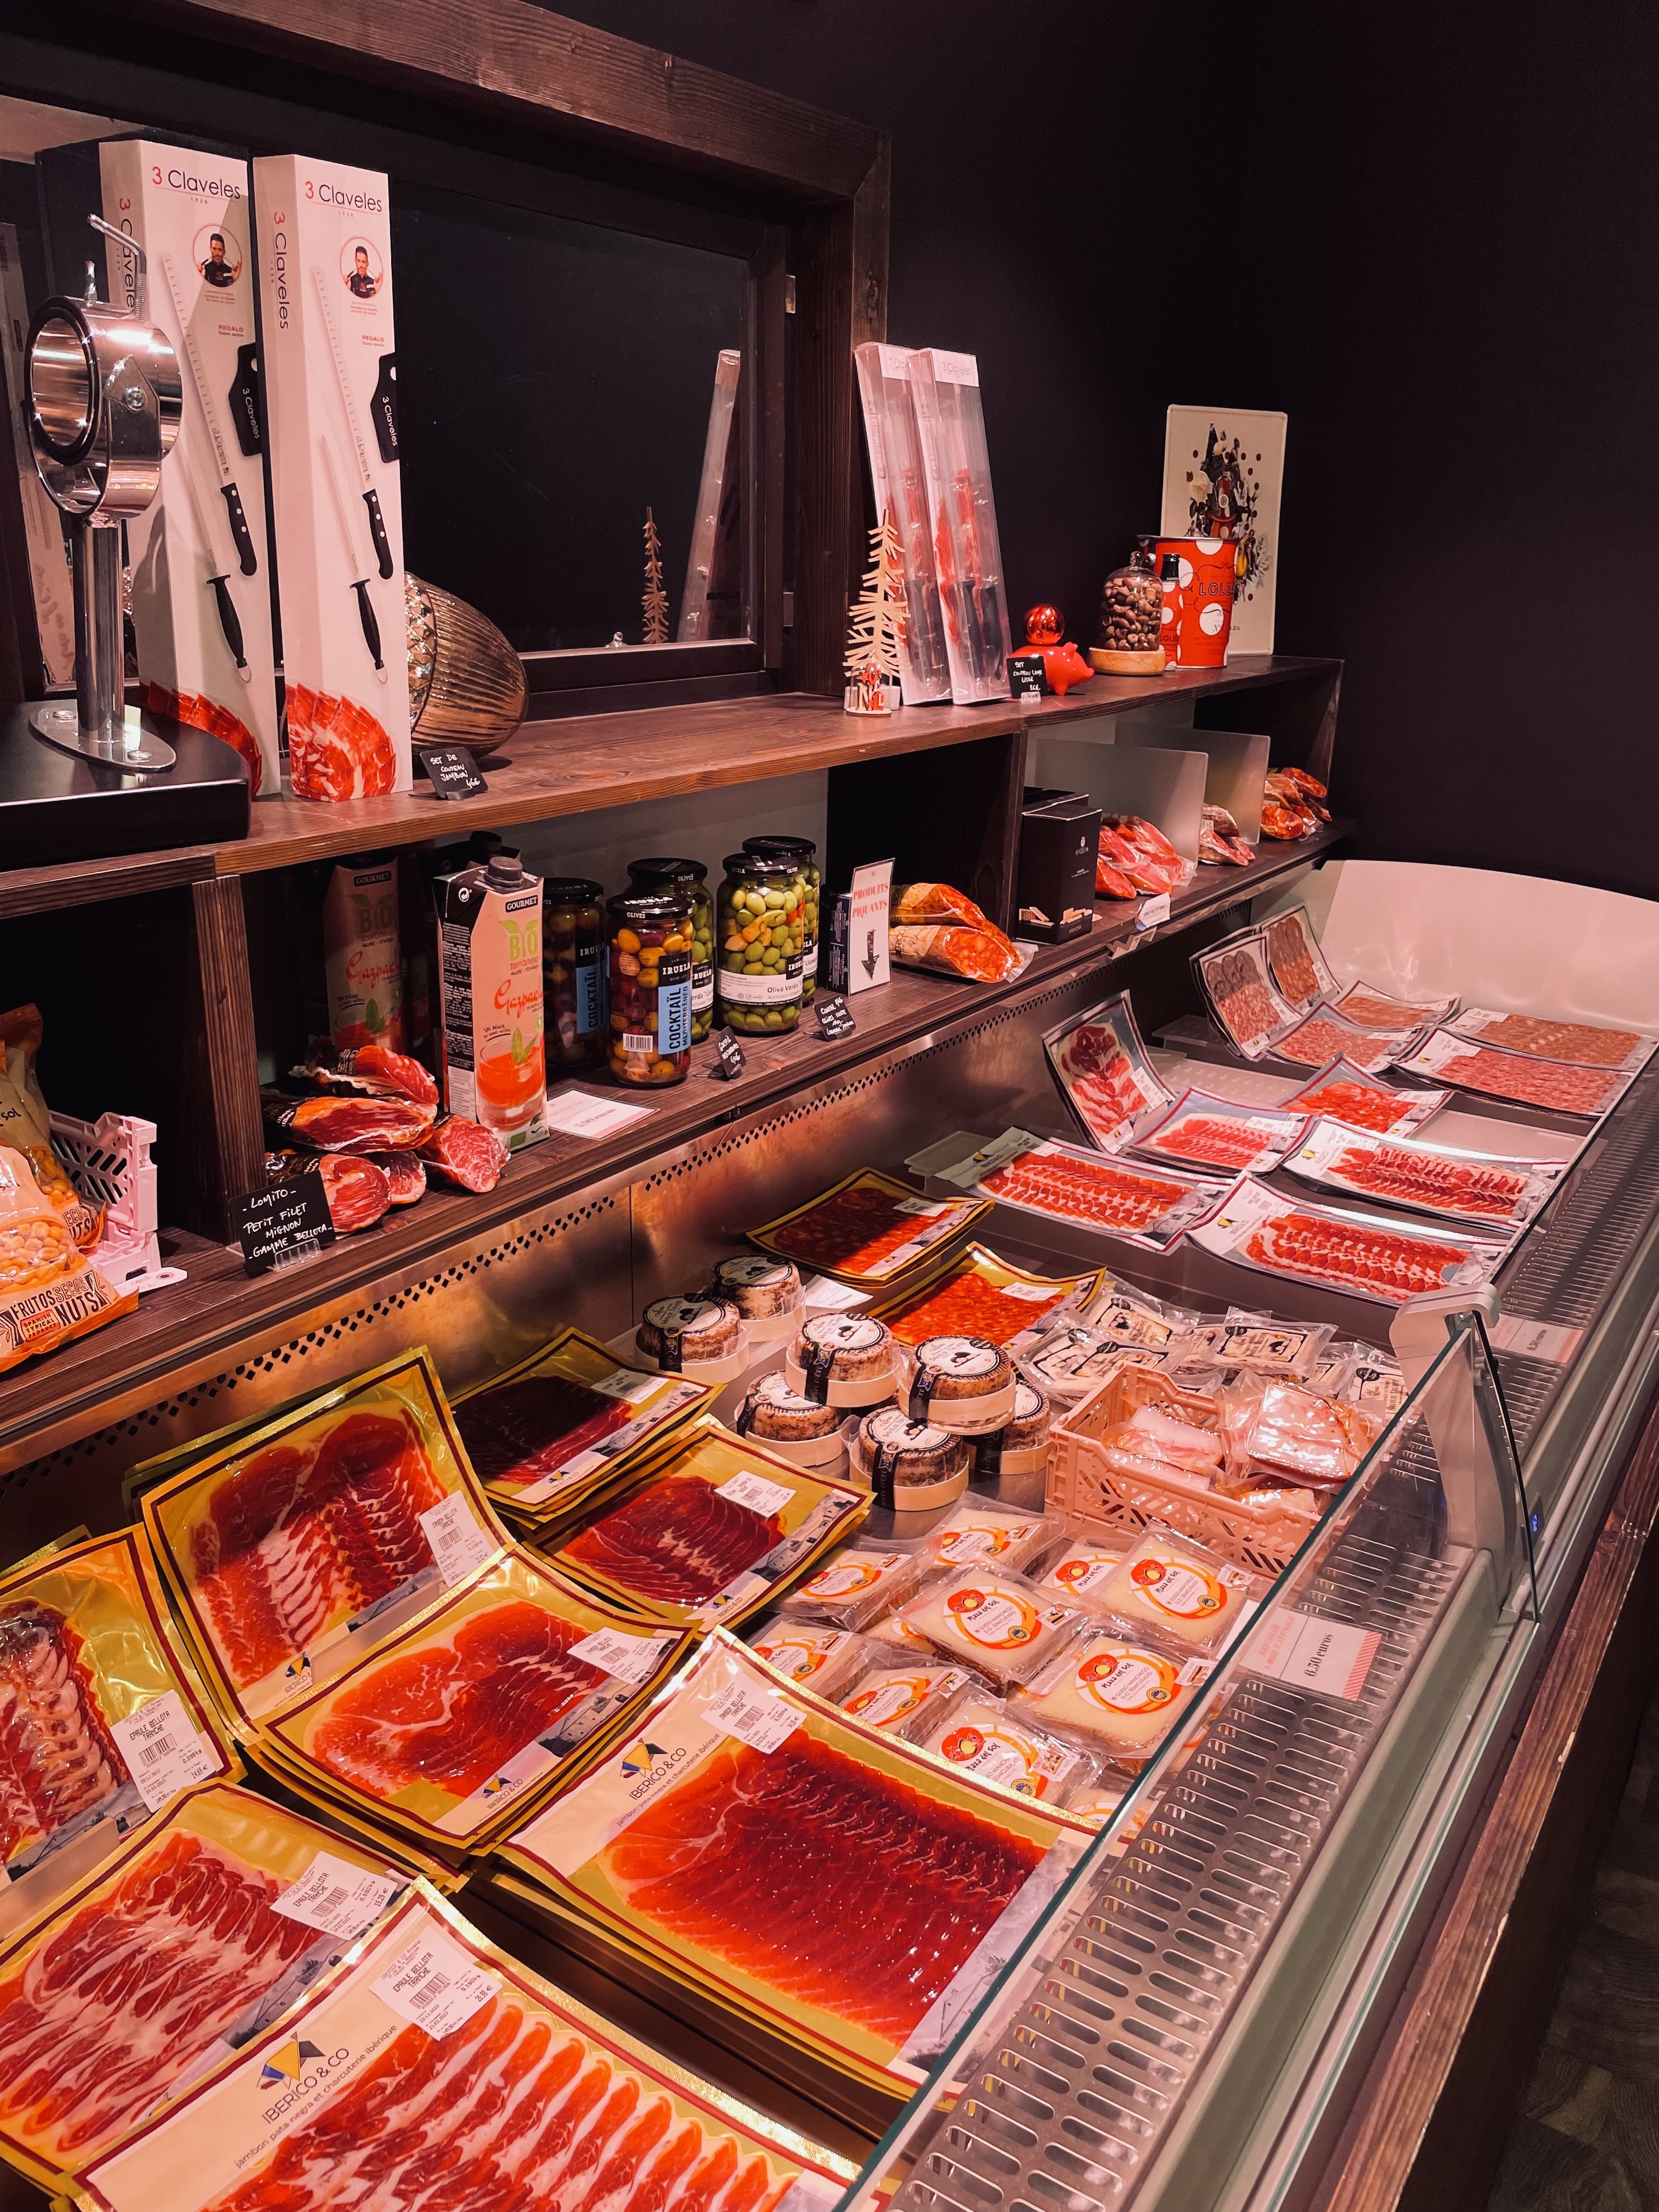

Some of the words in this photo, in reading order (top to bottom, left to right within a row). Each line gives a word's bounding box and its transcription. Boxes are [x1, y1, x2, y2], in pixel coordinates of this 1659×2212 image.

[152, 166, 162, 185] 3
[168, 170, 240, 199] Claveles
[120, 198, 131, 211] 3
[305, 181, 314, 199] 3
[319, 184, 382, 212] Claveles
[274, 212, 285, 224] 3
[275, 233, 290, 330] Claveles
[218, 324, 244, 332] REGALO
[947, 363, 971, 376] Claveles
[245, 397, 260, 439] Claveles
[385, 405, 398, 447] Claveles
[430, 756, 442, 765] SET
[357, 872, 390, 884] GOURMET
[853, 882, 889, 901] PRODUITS
[507, 896, 538, 911] GOURMET
[853, 899, 888, 918] PIQUANTS
[662, 961, 691, 975] IRUELA
[10, 1289, 57, 1319] FRUTOS
[53, 1277, 89, 1303] SECOS
[54, 1291, 99, 1327] NUTS
[24, 1312, 52, 1329] SPANISH
[25, 1318, 55, 1334] TYPICAL
[28, 1322, 57, 1339] PRODUCT
[1078, 1576, 1091, 1587] Plaza
[1155, 1582, 1168, 1594] Plaza
[1170, 1570, 1181, 1578] Sol
[967, 1611, 983, 1621] Plaza
[1261, 1624, 1280, 1658] MANCHEGO
[1316, 1633, 1334, 1658] euros
[1266, 1650, 1278, 1666] MOIS
[284, 1674, 308, 1694] IBERICO
[1101, 1676, 1118, 1688] Plaza
[1115, 1669, 1126, 1678] del
[129, 1723, 149, 1741] EPAULE
[149, 1710, 171, 1729] BELLOTA
[666, 1778, 673, 1786] et
[672, 1752, 701, 1780] charcuterie
[699, 1733, 720, 1756] ibérique
[981, 1750, 991, 1760] del
[988, 1742, 1001, 1752] Sol
[628, 1767, 667, 1801] IBERICO
[663, 1759, 675, 1769] &
[670, 1748, 686, 1761] CO
[487, 1791, 510, 1809] IBERICO
[513, 1779, 523, 1788] CO
[293, 1891, 311, 1907] EPAULE
[309, 1872, 330, 1893] BELLOTA
[393, 1972, 413, 1993] EPAULE
[411, 1952, 434, 1974] BELLOTA
[461, 1974, 481, 1991] 0.180kg
[261, 2075, 318, 2124] IBERICO
[316, 2067, 331, 2079] &
[328, 2048, 349, 2067] CO
[234, 2140, 270, 2169] jambon
[270, 2121, 290, 2141] pata
[290, 2101, 313, 2124] negra
[314, 2091, 324, 2102] et
[324, 2053, 366, 2094] charcuterie
[364, 2024, 397, 2055] ibérique
